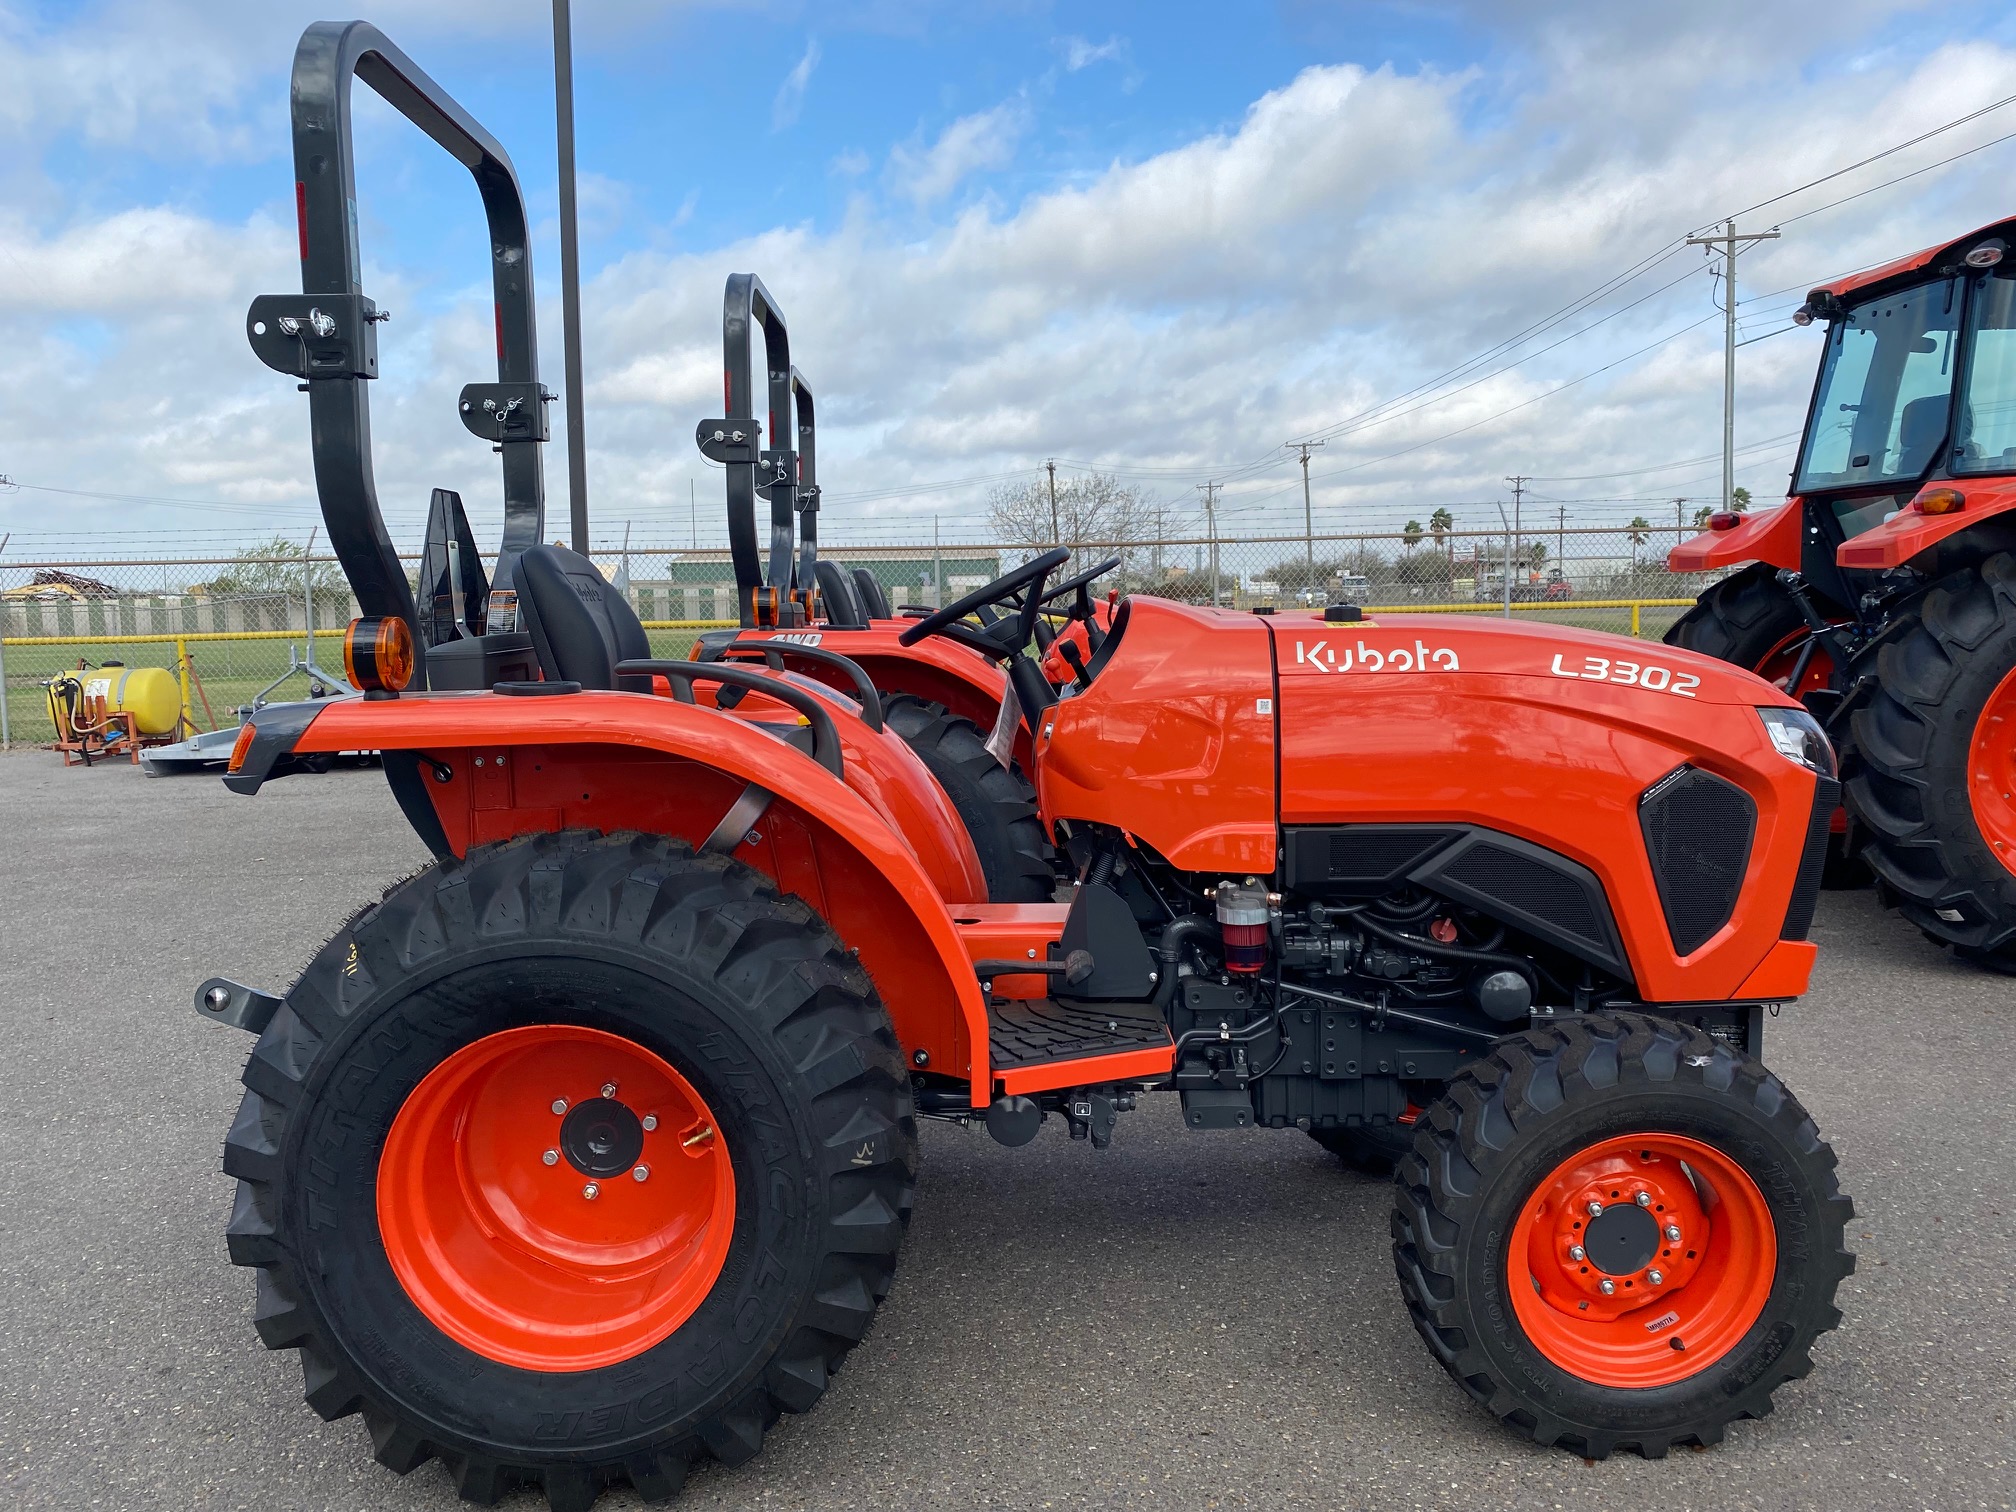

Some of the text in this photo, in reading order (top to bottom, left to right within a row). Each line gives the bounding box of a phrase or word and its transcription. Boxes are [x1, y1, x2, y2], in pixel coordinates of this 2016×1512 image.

[767, 633, 823, 648] 4WD
[1296, 640, 1460, 673] Kubota
[1551, 653, 1701, 698] L3302
[305, 1010, 419, 1233] TITAN
[531, 1024, 796, 1440] TRAC LOADER
[1759, 1156, 1810, 1263] TITAN
[1481, 1228, 1556, 1393] TRAC LOADER
